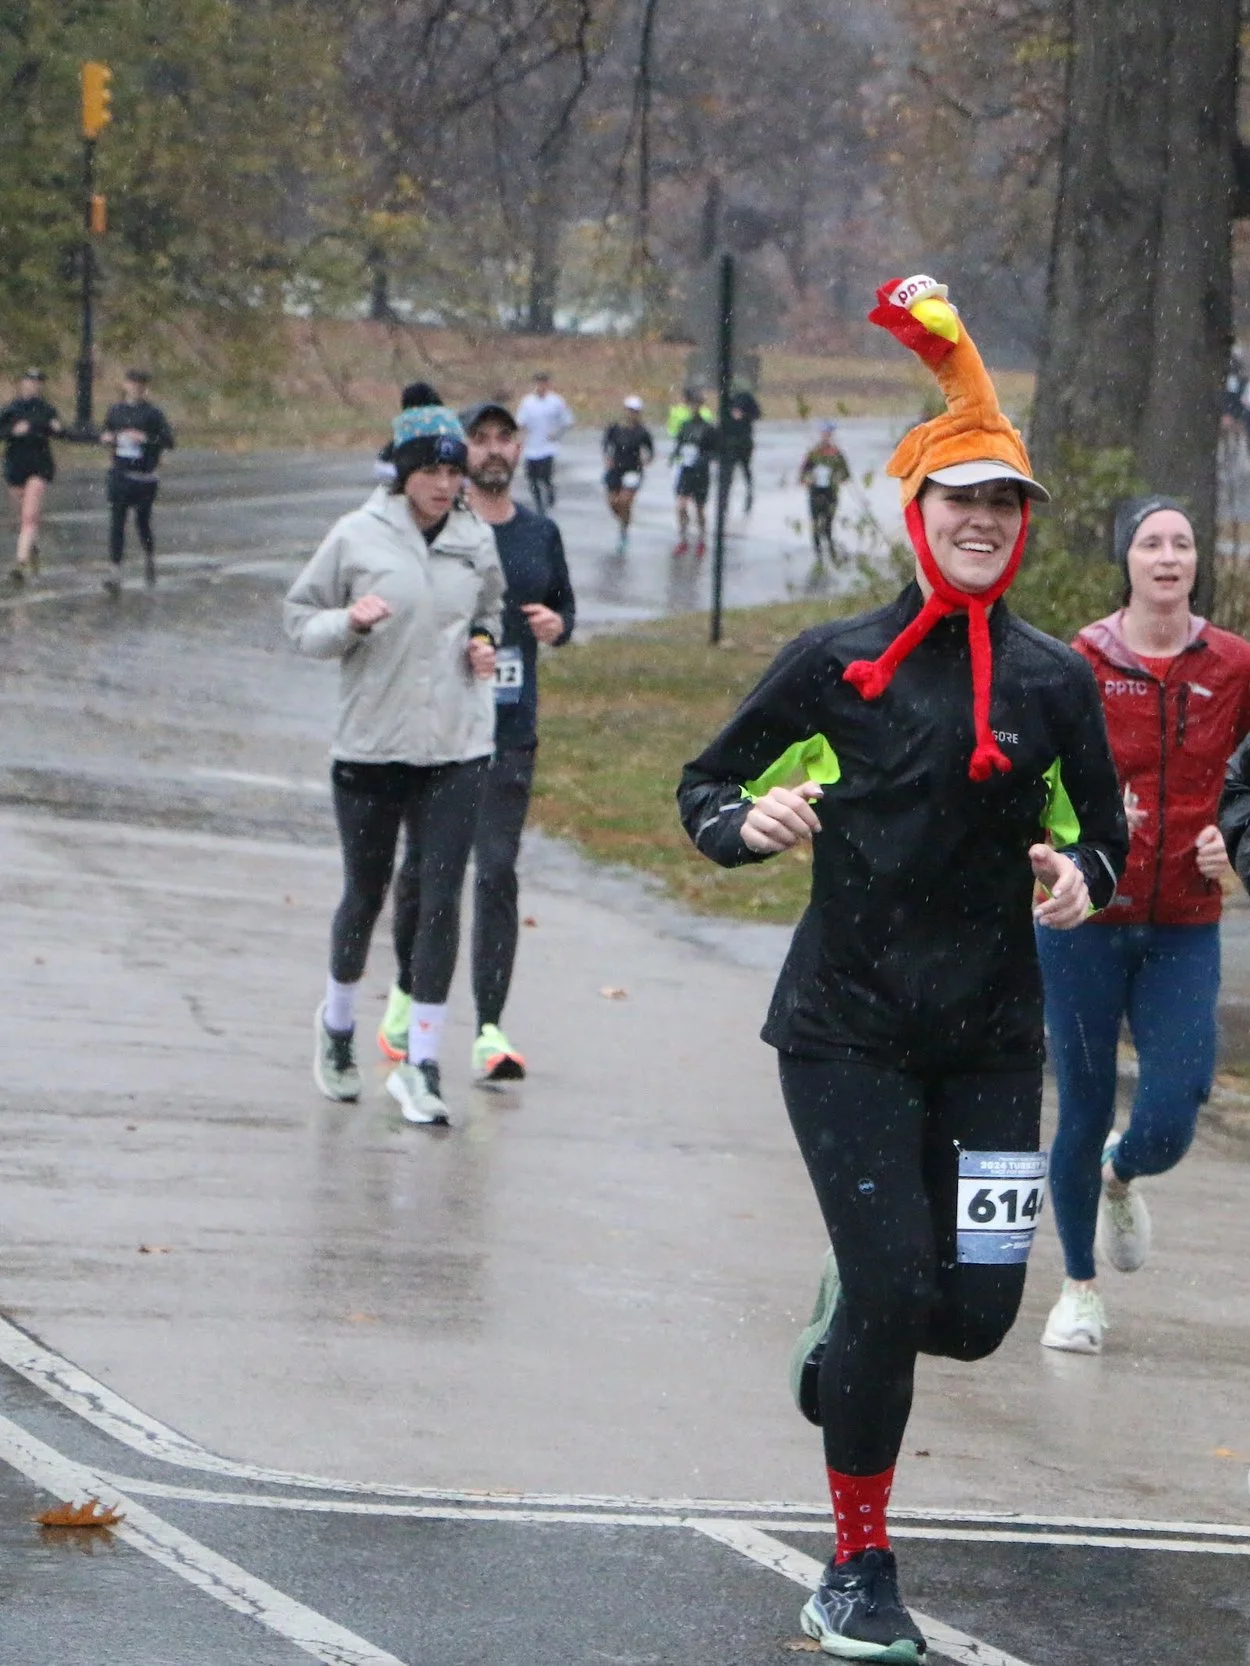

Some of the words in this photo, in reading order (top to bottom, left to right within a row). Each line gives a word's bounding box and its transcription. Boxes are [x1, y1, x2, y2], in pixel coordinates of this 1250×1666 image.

[1104, 680, 1148, 697] PPTC
[991, 730, 1019, 744] GORE
[980, 1161, 1007, 1170] 2024
